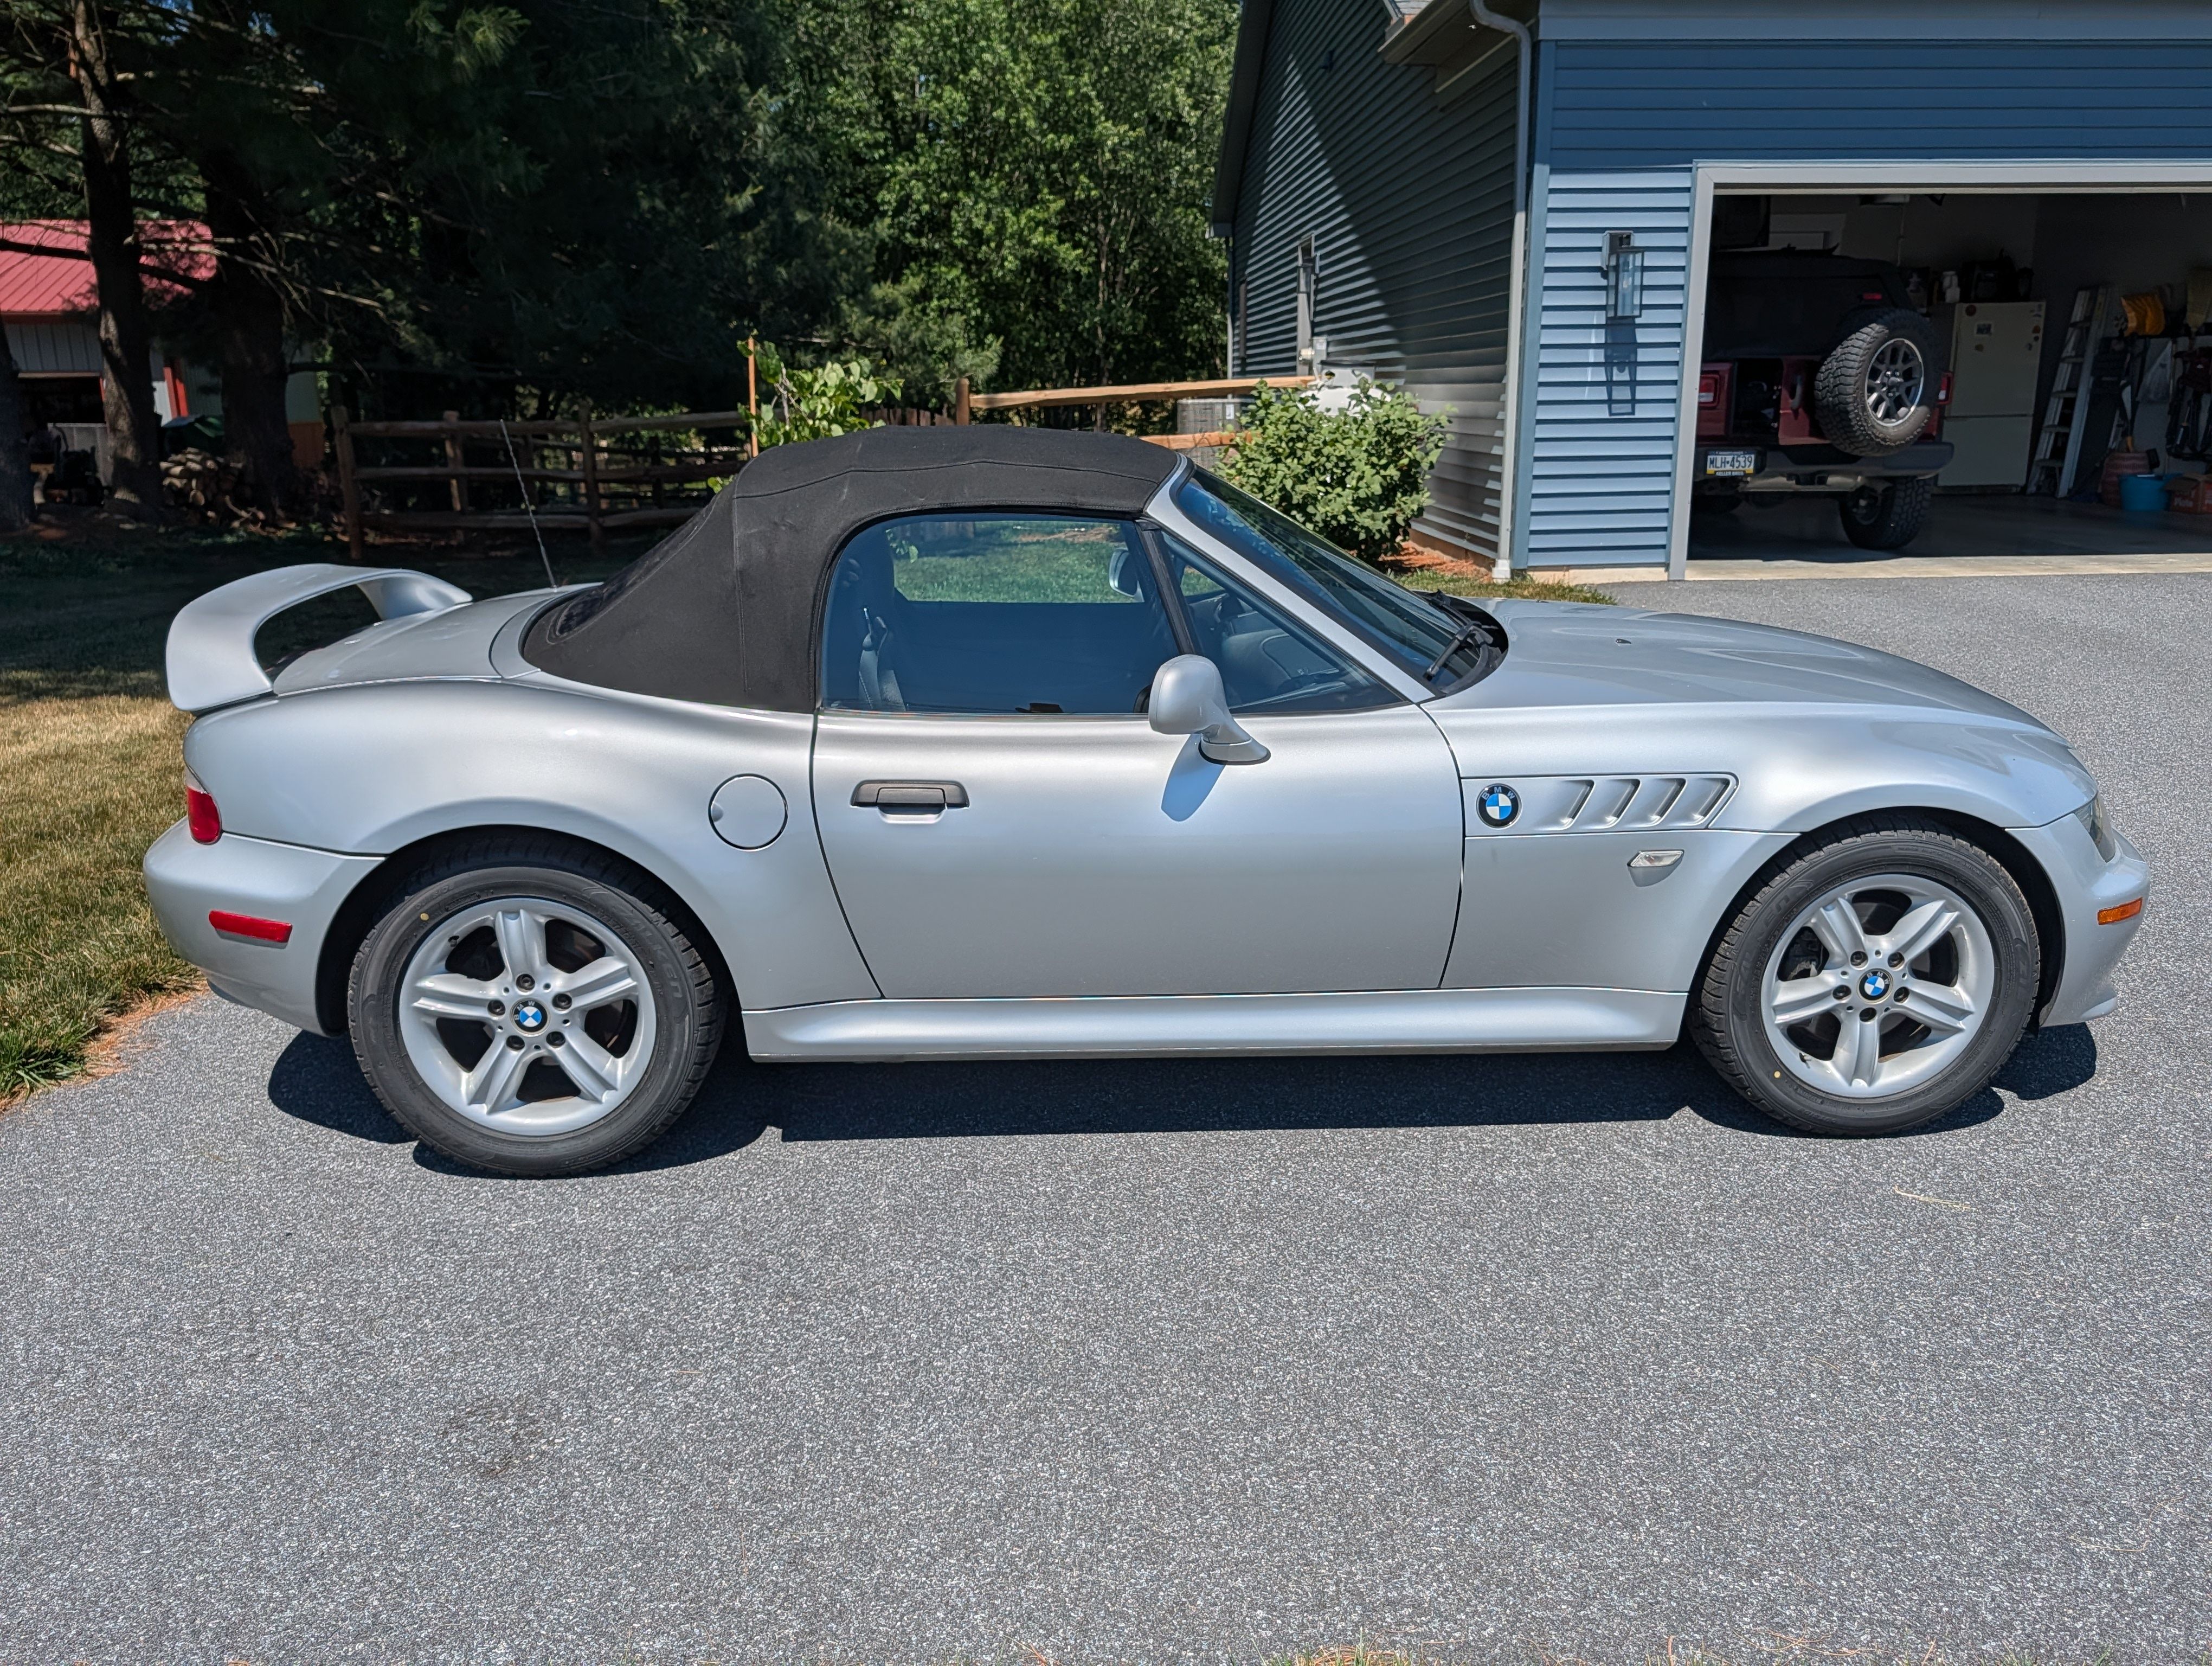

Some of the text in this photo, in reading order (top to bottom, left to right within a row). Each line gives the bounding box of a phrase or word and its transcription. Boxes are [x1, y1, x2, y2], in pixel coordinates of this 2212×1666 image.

[1481, 786, 1515, 800] BMW
[1867, 971, 1890, 984] BMW
[514, 1000, 535, 1021] BMW
